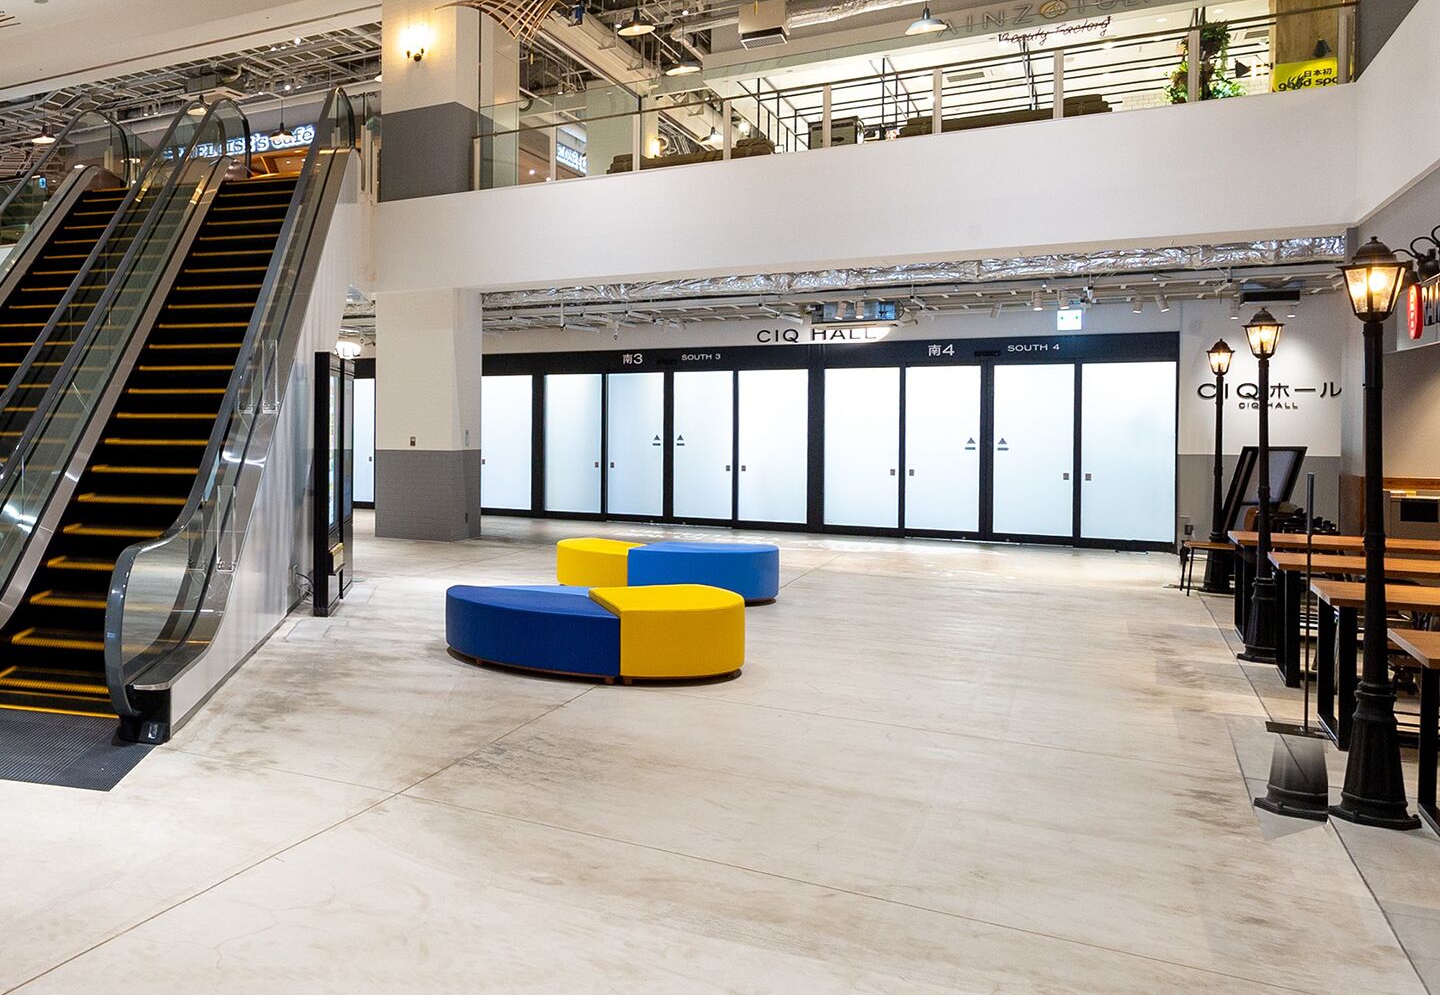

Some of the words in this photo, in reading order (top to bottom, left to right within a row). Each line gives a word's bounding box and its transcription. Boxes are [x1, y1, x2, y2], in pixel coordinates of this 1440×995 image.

[937, 3, 1032, 37] AINZ
[1304, 68, 1332, 77] 日本初
[757, 329, 799, 343] CIQ
[812, 328, 877, 341] HALL
[928, 344, 955, 356] 南4
[1007, 344, 1048, 352] SOUTH
